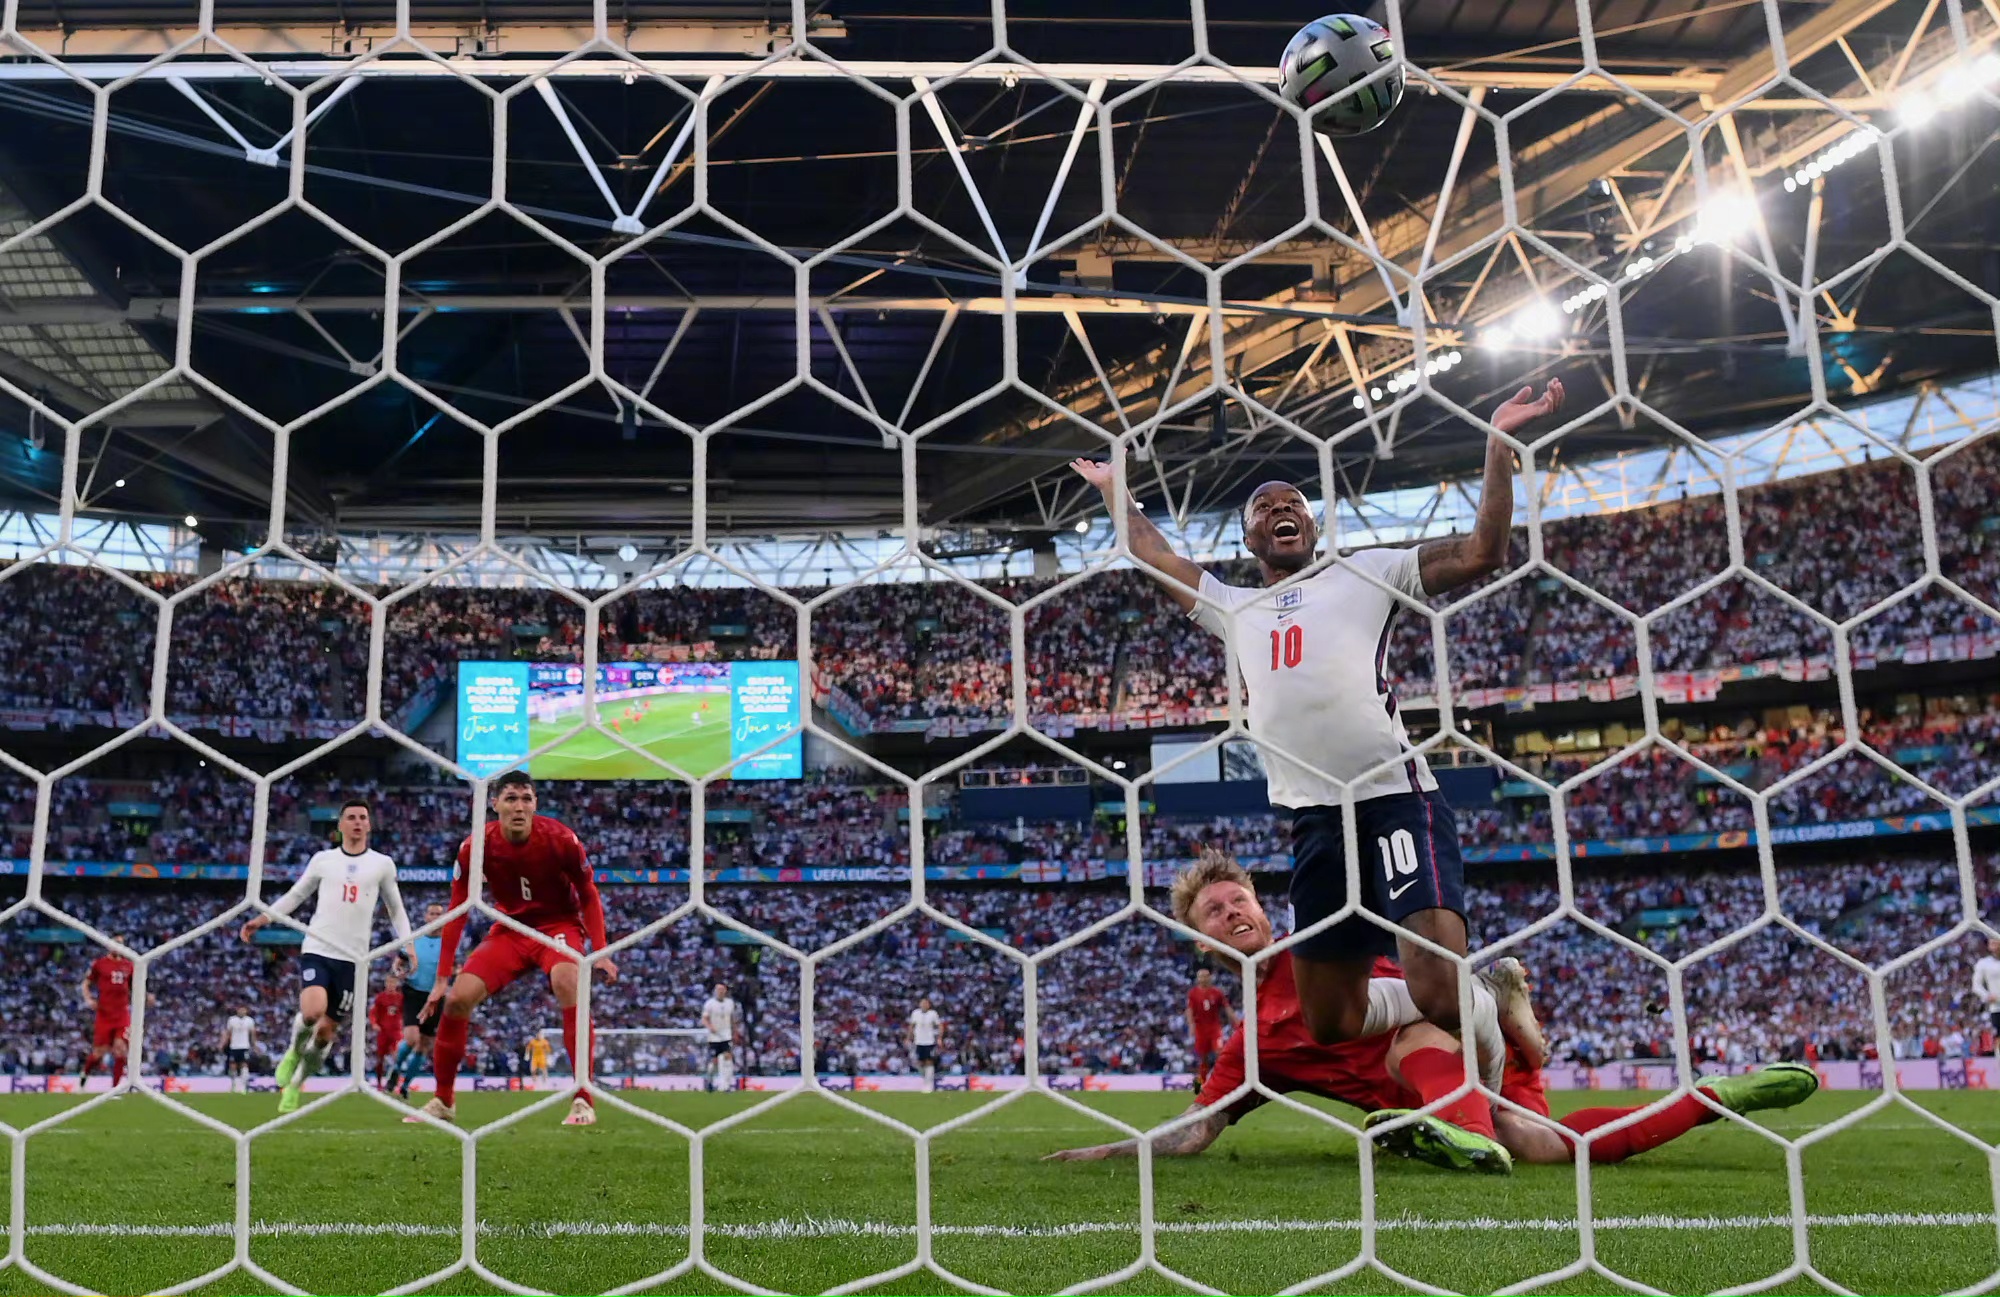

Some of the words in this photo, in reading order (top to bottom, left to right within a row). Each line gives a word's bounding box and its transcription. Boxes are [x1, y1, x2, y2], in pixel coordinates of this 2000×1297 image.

[1270, 624, 1304, 671] 10
[1377, 828, 1419, 882] 10
[398, 868, 448, 881] ONDON
[813, 868, 846, 881] UEFA
[343, 884, 357, 903] 19
[520, 876, 532, 900] 6
